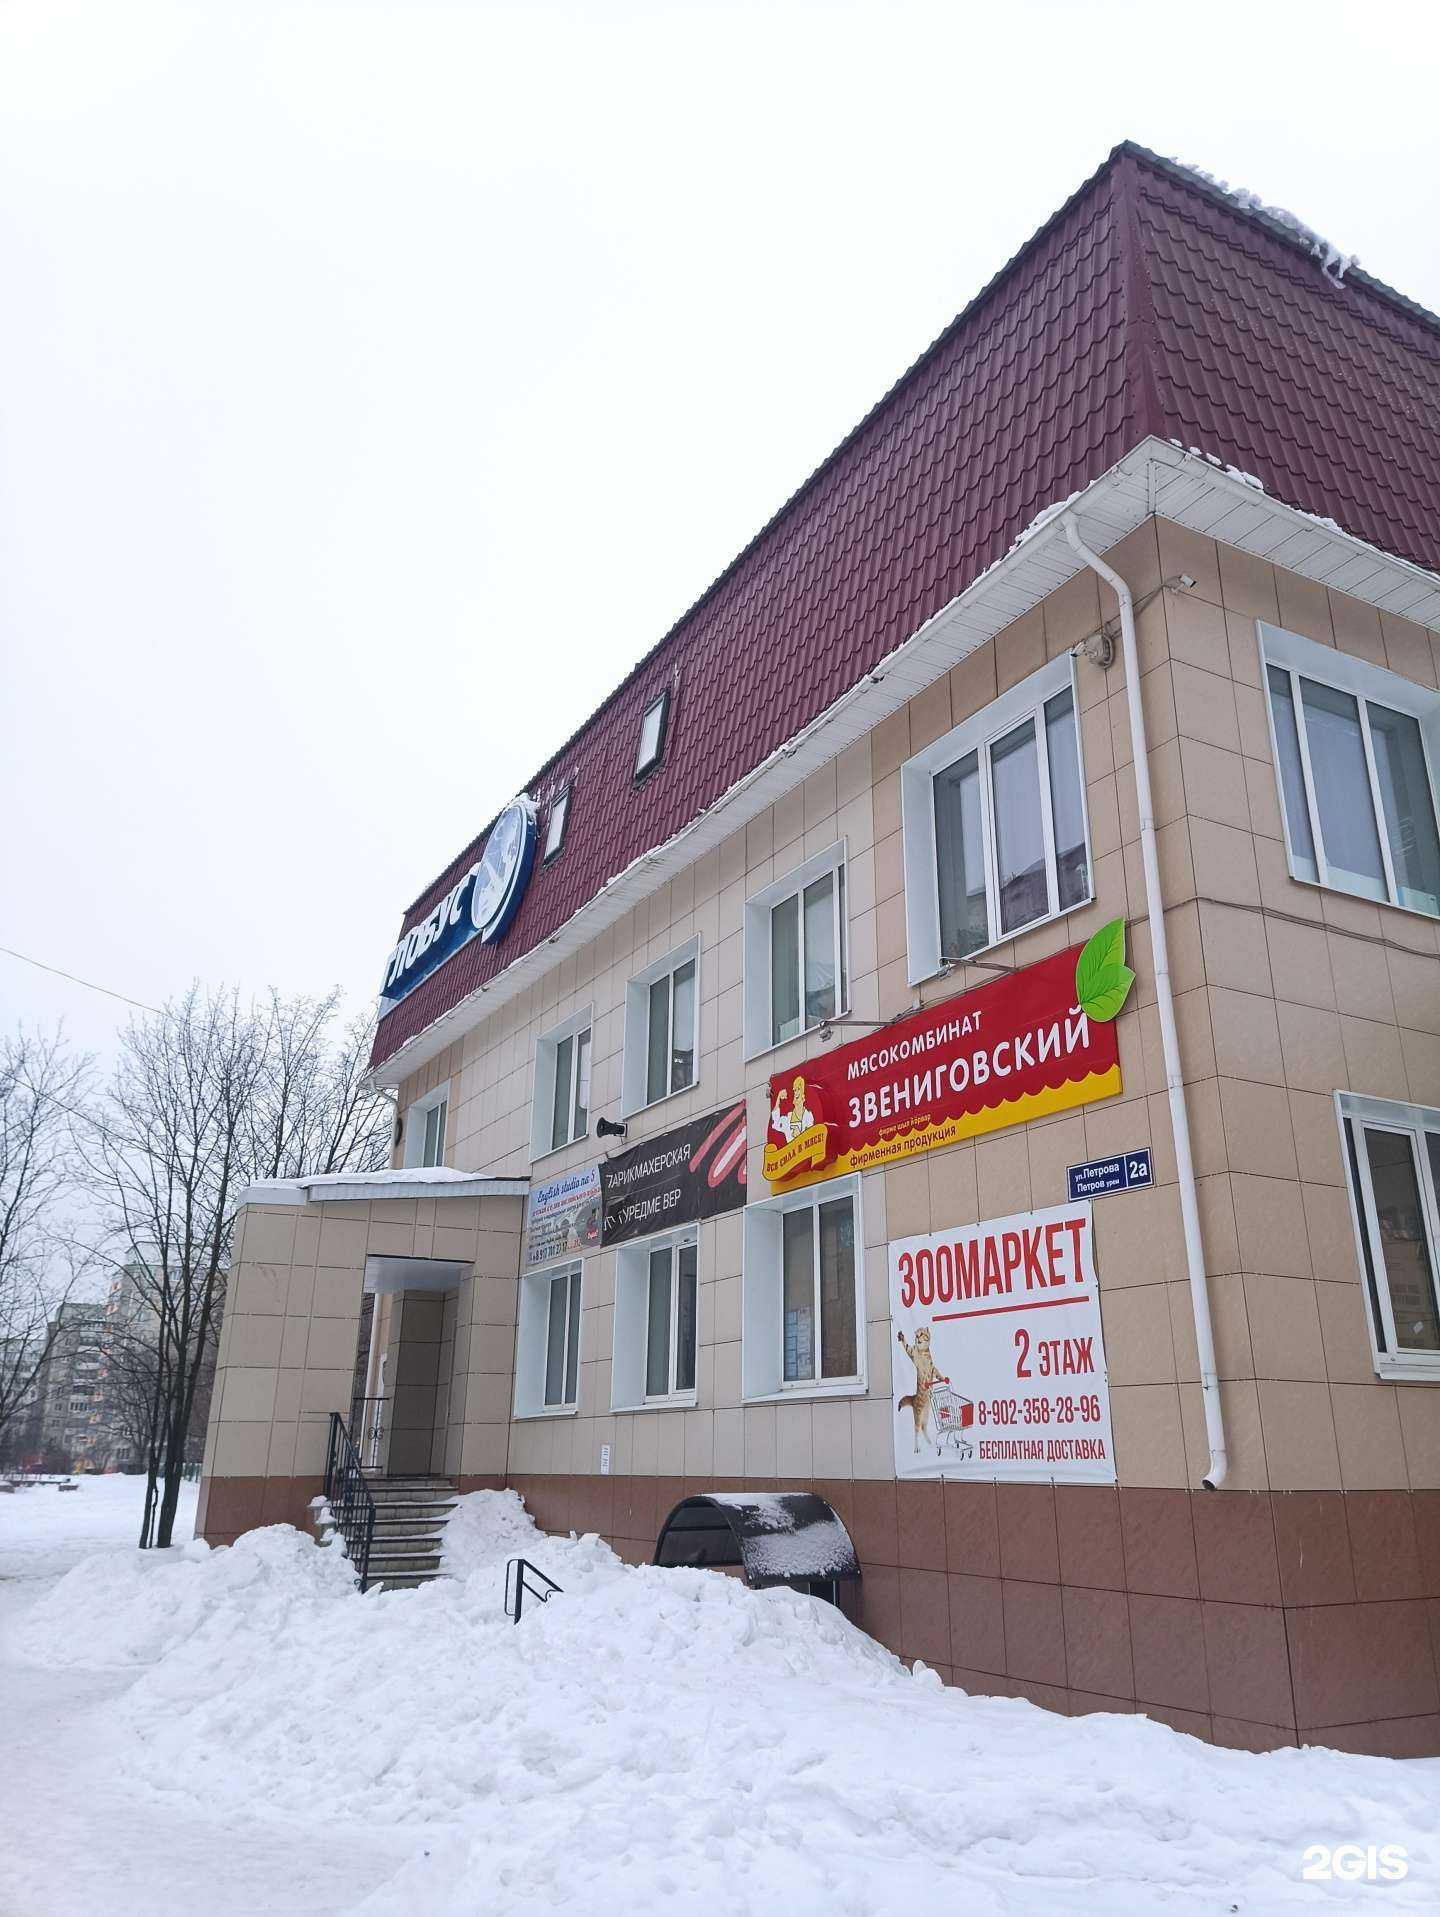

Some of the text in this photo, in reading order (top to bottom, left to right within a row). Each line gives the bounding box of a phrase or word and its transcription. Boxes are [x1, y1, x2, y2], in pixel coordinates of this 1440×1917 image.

[847, 1011, 982, 1080] МЯСОКОМБИНАТ
[848, 1004, 1089, 1128] ЗВЕНИГОВСКИЙ
[850, 1125, 956, 1168] фирменная продукция
[1077, 1180, 1105, 1193] Петров
[1129, 1161, 1148, 1179] 2а
[663, 1188, 681, 1210] ВЕР
[898, 1218, 1086, 1308] ЗООМАРКЕТ
[1014, 1328, 1095, 1378] 2 ЭТАЖ
[978, 1394, 1101, 1426] 8-902-358-28-96
[979, 1438, 1106, 1463] БЕСПЛАТНАЯ ДОСТАВКА
